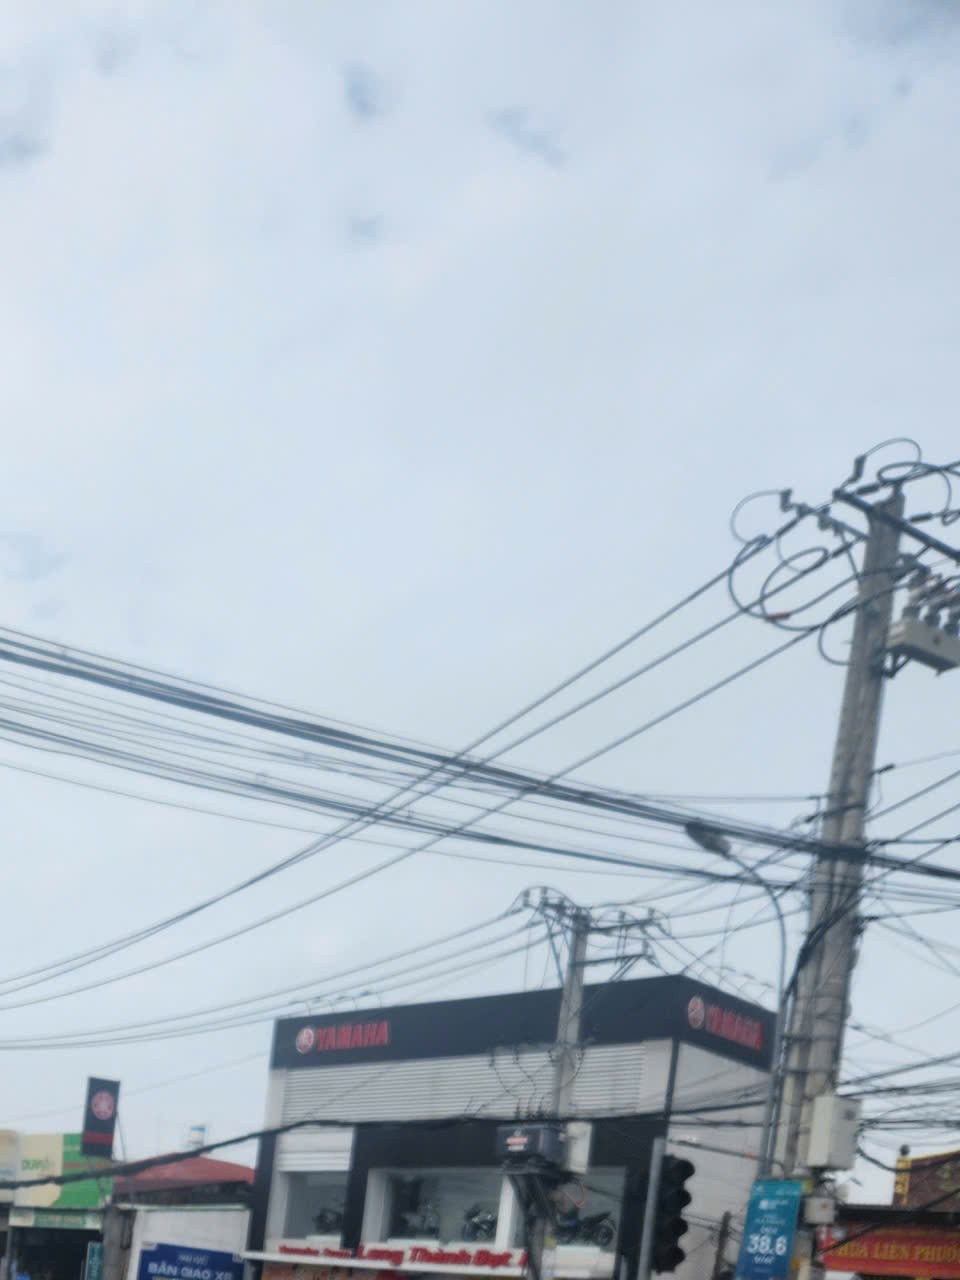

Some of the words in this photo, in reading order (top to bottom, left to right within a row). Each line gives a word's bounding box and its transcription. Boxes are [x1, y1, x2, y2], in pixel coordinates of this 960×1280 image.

[316, 1020, 389, 1051] YAMAHA
[705, 1005, 763, 1050] YAMAHA
[747, 1233, 787, 1256] 38.6
[180, 1265, 211, 1280] GIAO
